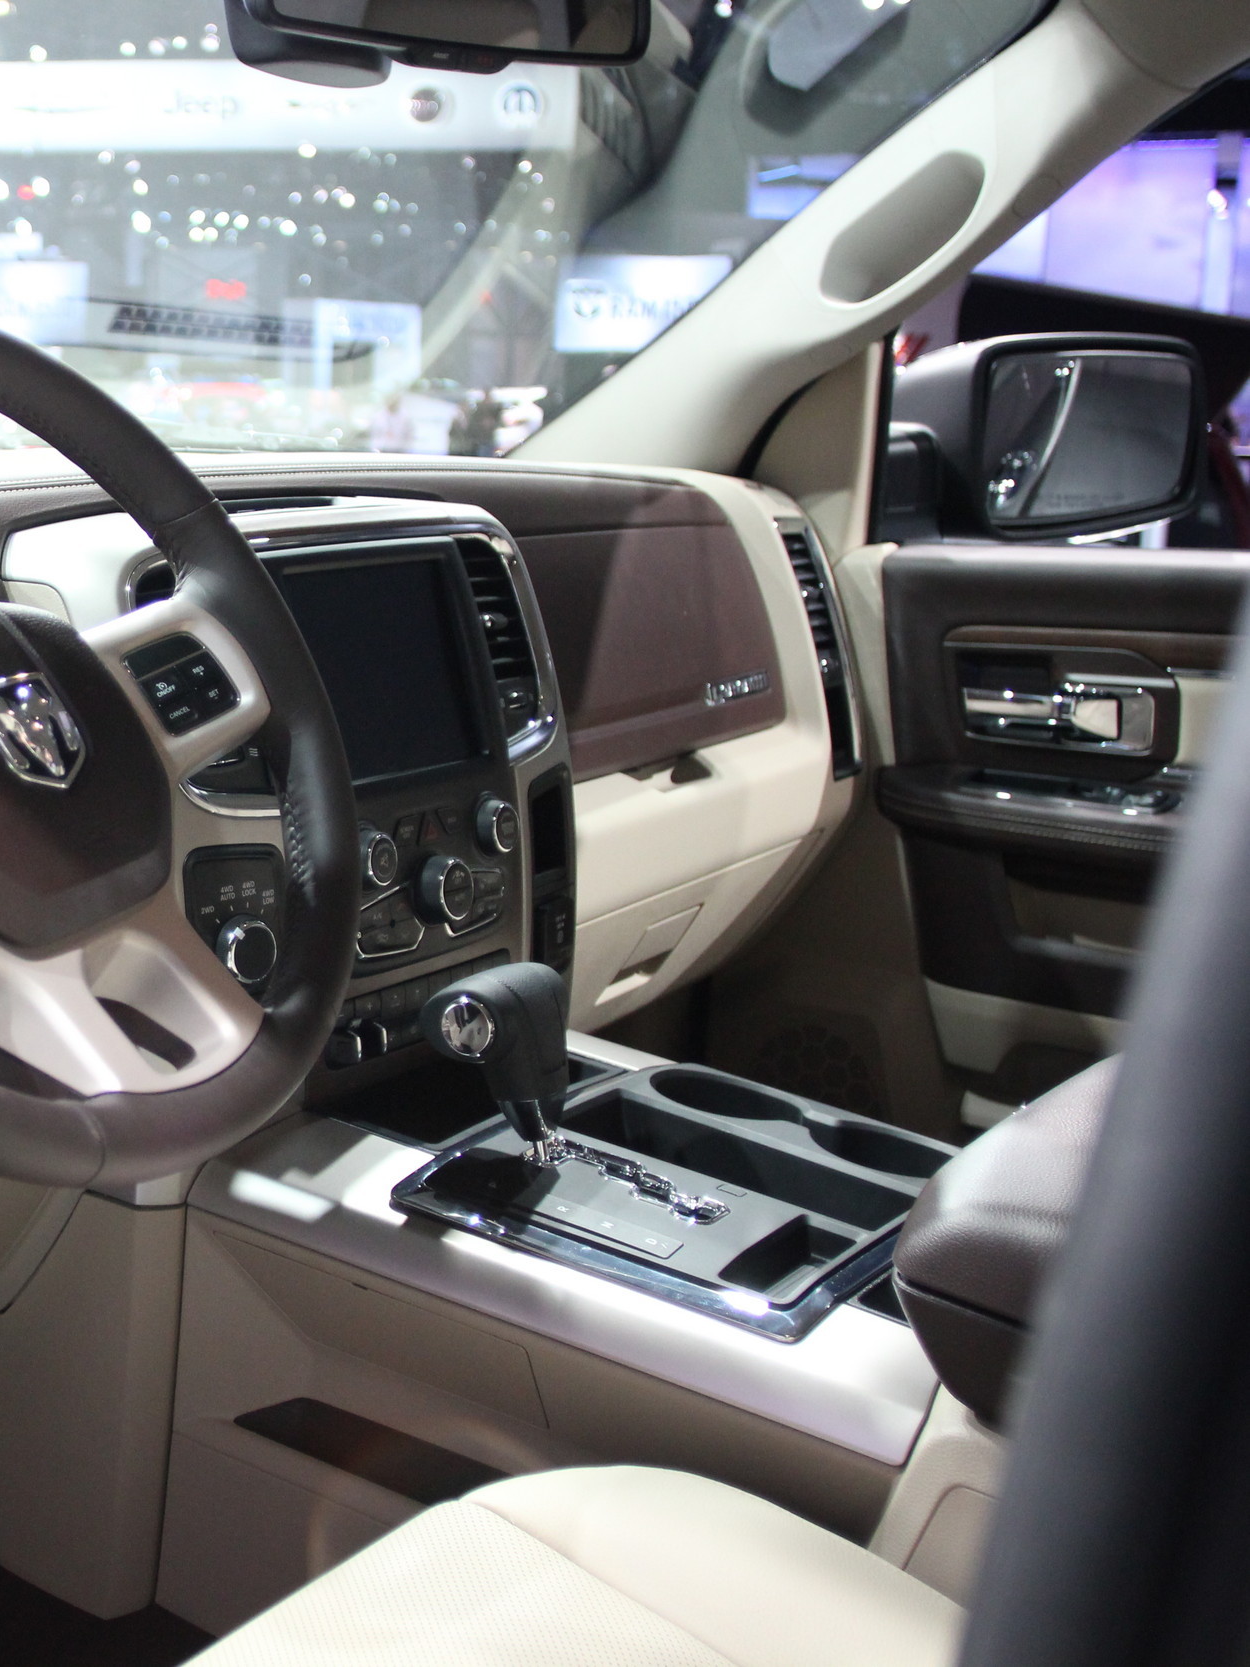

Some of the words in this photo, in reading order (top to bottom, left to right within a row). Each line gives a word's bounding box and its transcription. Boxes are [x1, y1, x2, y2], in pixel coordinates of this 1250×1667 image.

[163, 88, 241, 120] Jeep
[192, 665, 205, 674] RES
[169, 705, 190, 720] CANCEL
[221, 885, 234, 893] 4WD
[242, 888, 257, 897] LOCK
[262, 889, 274, 897] 4WD
[220, 893, 235, 901] AUTO
[262, 896, 275, 905] LOW
[201, 905, 214, 914] 2WD
[556, 1204, 569, 1214] R
[645, 1237, 658, 1246] D
